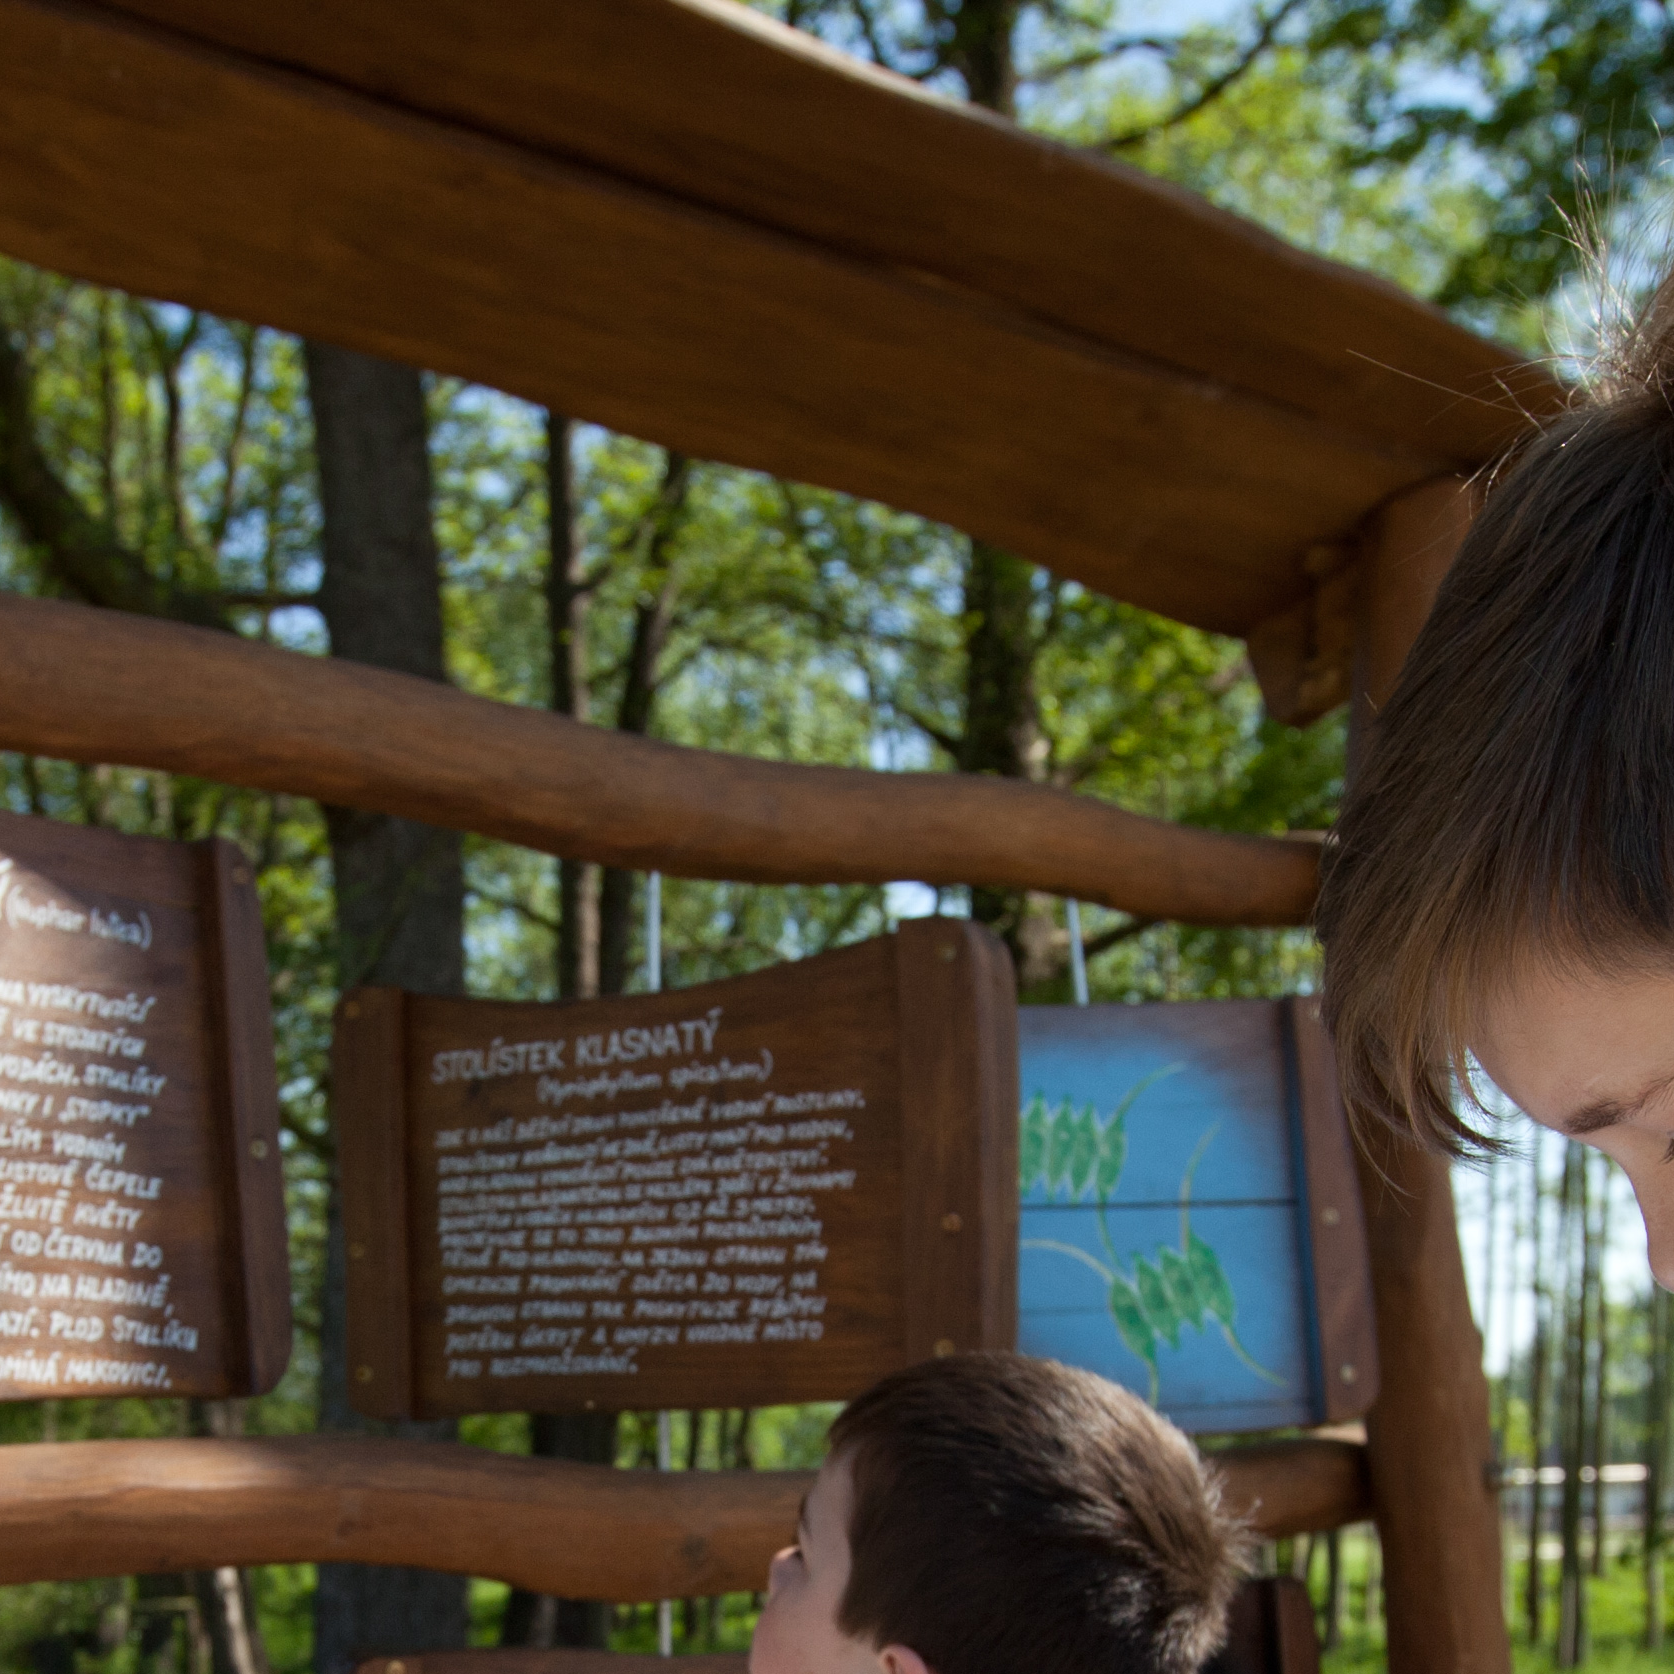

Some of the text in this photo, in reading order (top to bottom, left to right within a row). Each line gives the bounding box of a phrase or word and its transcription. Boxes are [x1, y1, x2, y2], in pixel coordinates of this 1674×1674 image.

[13, 1016, 41, 1043] VE
[42, 1021, 146, 1059] STOJATÝCH
[431, 1007, 722, 1084] STOLÍSTEK KLASNATÝ
[84, 1063, 167, 1098] STULÍKY
[42, 1094, 54, 1119] I
[51, 1130, 127, 1164] VODNÍM
[85, 1160, 163, 1200] ČEPELE
[73, 1198, 143, 1232] KVĚTY
[10, 1229, 43, 1258] OD
[43, 1225, 125, 1268] ČERVNA
[131, 1241, 164, 1269] DO
[39, 1272, 72, 1299] NA
[75, 1272, 174, 1318] HLADINĚ,
[49, 1309, 105, 1343] PLOD
[111, 1314, 200, 1352] STULÍKU
[592, 1326, 606, 1345] A
